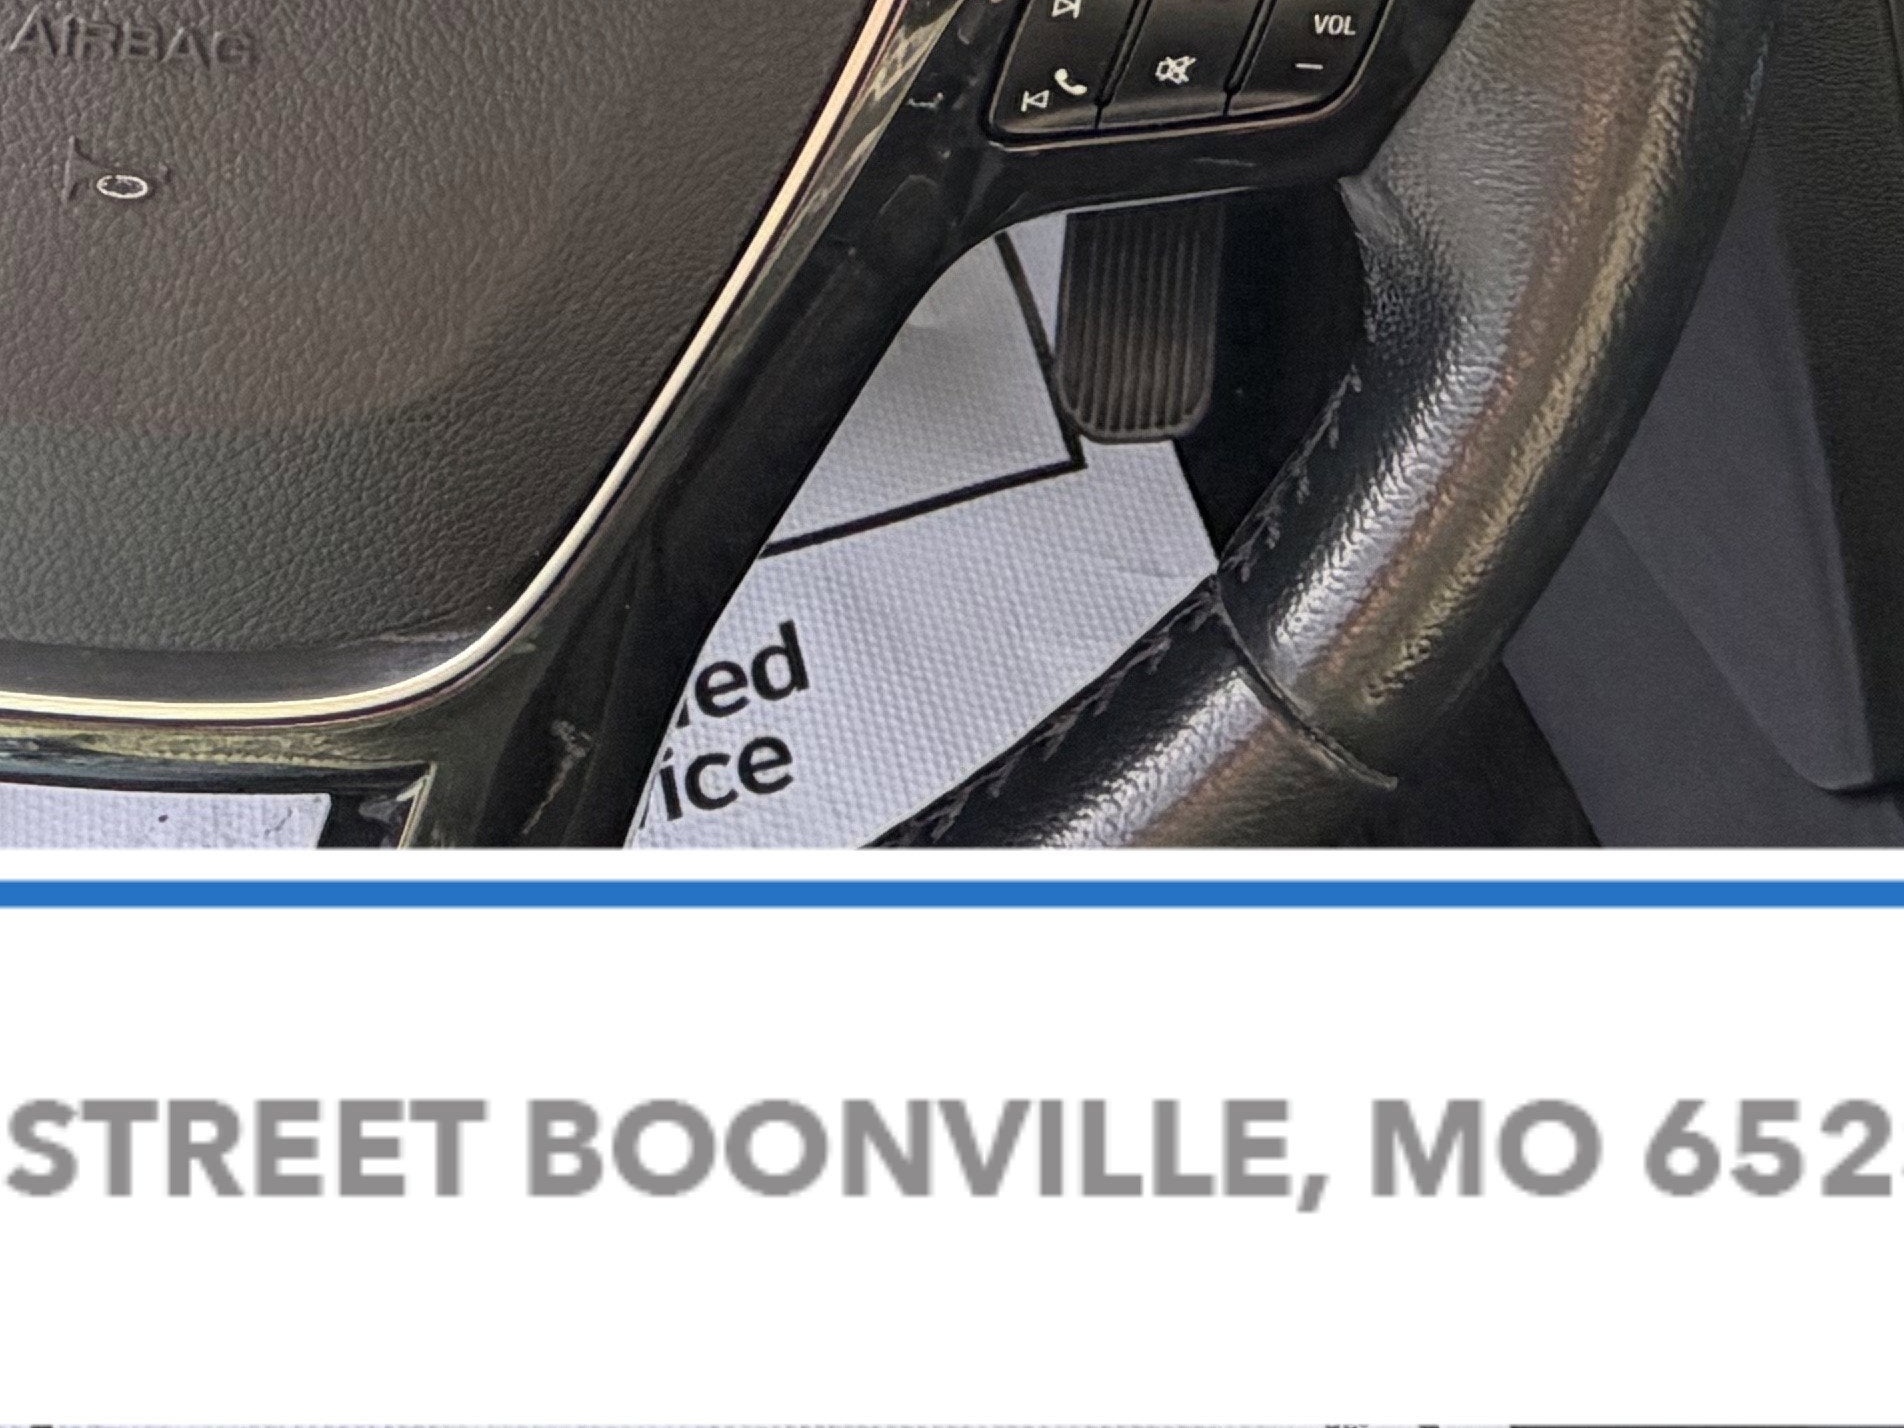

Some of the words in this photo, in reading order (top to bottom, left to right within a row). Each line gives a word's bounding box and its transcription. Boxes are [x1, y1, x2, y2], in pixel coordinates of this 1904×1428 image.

[8, 5, 259, 72] AIRBAG
[1313, 13, 1356, 36] VOL
[639, 736, 794, 829] ice
